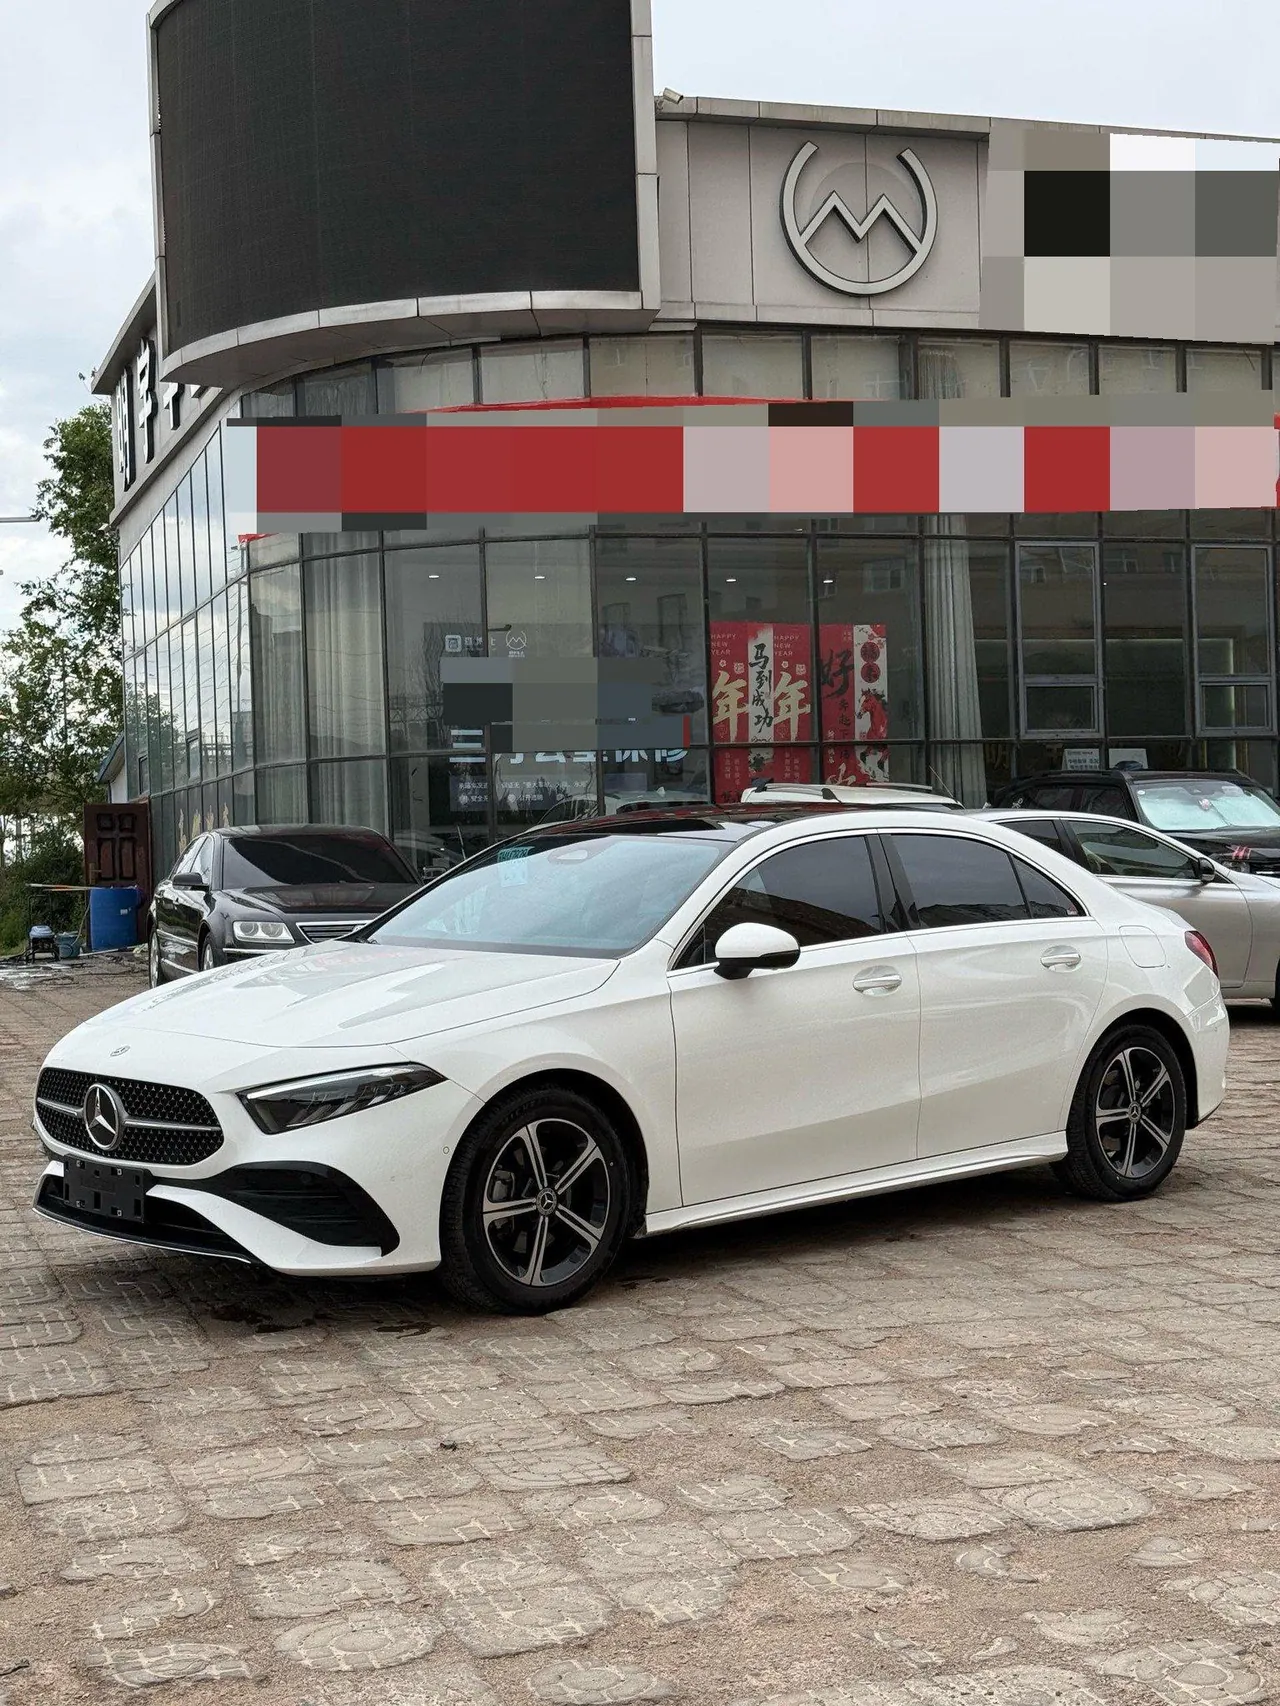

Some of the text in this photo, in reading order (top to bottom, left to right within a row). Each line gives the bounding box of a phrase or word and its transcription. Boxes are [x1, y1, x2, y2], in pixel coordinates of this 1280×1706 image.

[712, 670, 749, 743] 年
[748, 642, 774, 734] 马到成功
[773, 671, 811, 743] 年
